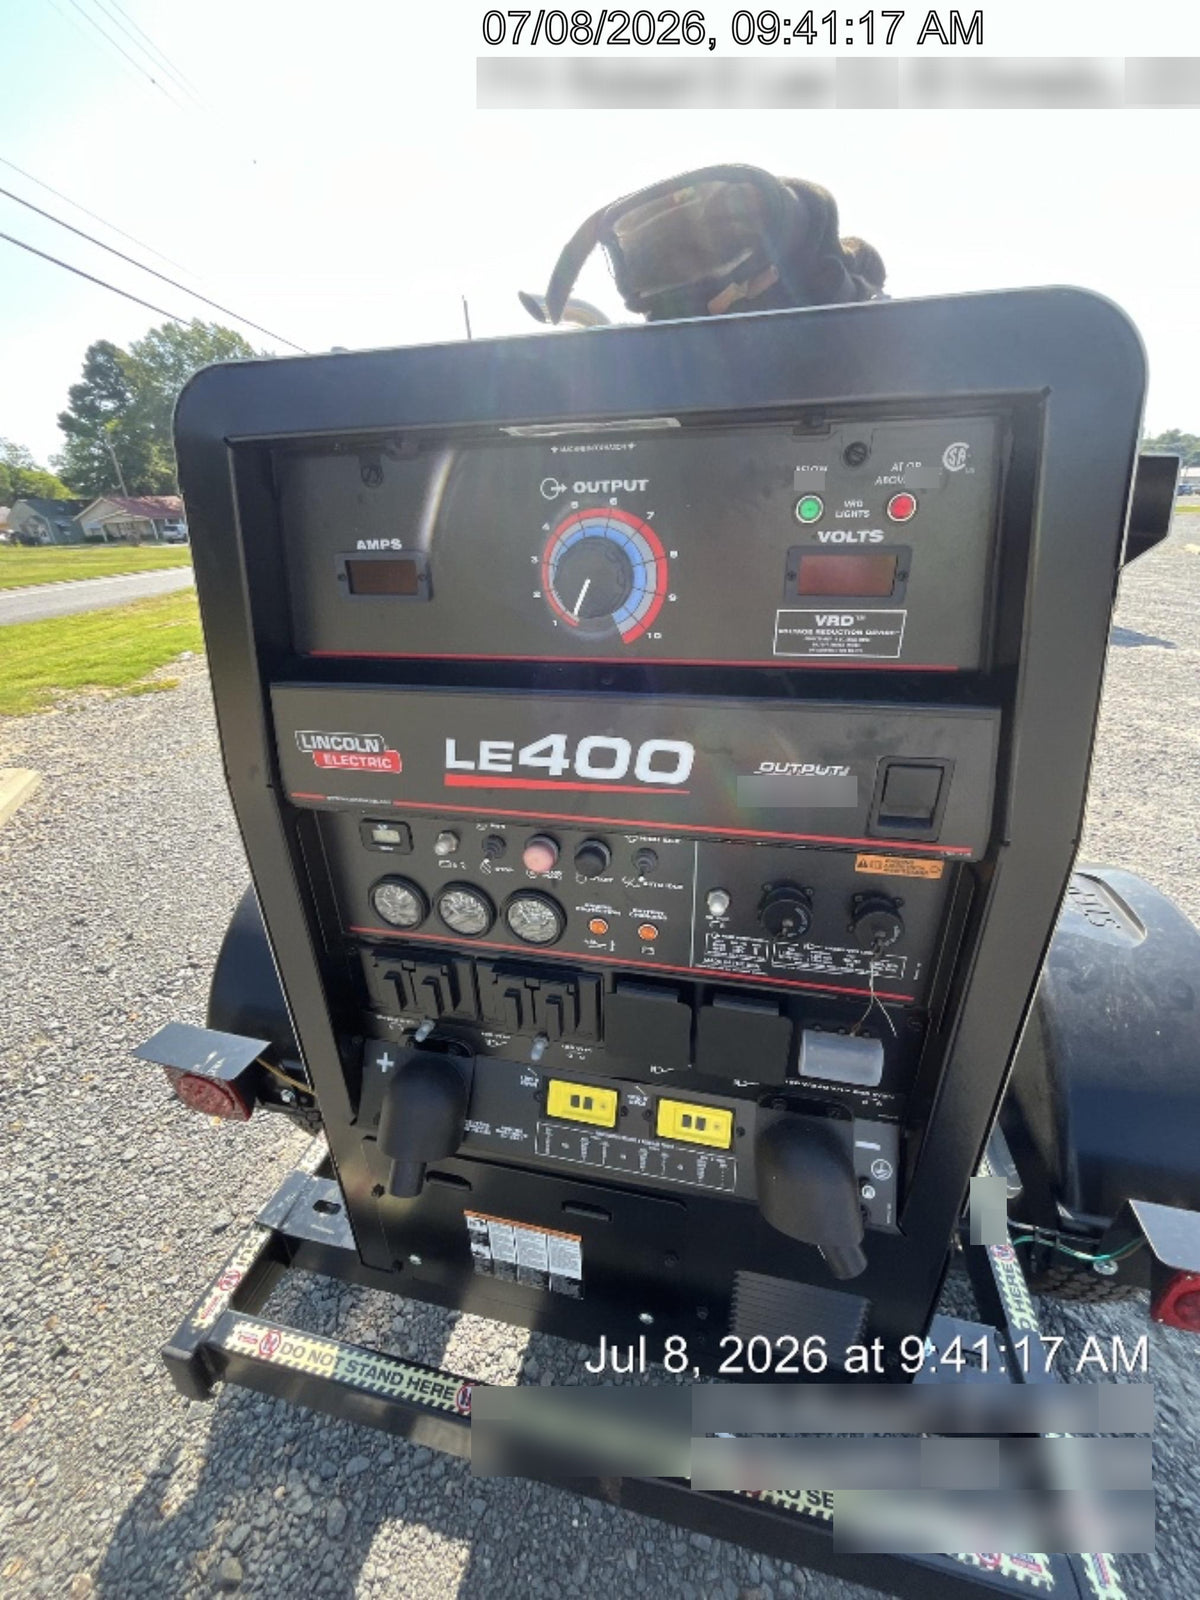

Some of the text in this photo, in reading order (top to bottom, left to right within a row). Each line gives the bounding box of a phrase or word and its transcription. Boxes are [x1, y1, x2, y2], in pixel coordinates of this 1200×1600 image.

[573, 479, 650, 493] OUTPUT
[875, 476, 906, 486] ABOV
[609, 497, 618, 506] 6
[646, 511, 655, 520] 7
[835, 510, 870, 519] LIGHTS
[542, 523, 550, 531] 4
[817, 529, 885, 543] VOLTS
[356, 538, 402, 550] AMPS
[530, 556, 538, 564] 3
[533, 590, 541, 599] 2
[552, 619, 558, 627] 1
[646, 632, 662, 640] 10
[301, 734, 380, 753] LINCOLN
[323, 753, 393, 769] ELECTRIC
[445, 733, 695, 785] LE400
[758, 762, 844, 775] OUTPUT
[280, 1342, 457, 1400] DO NOT STAND HERE
